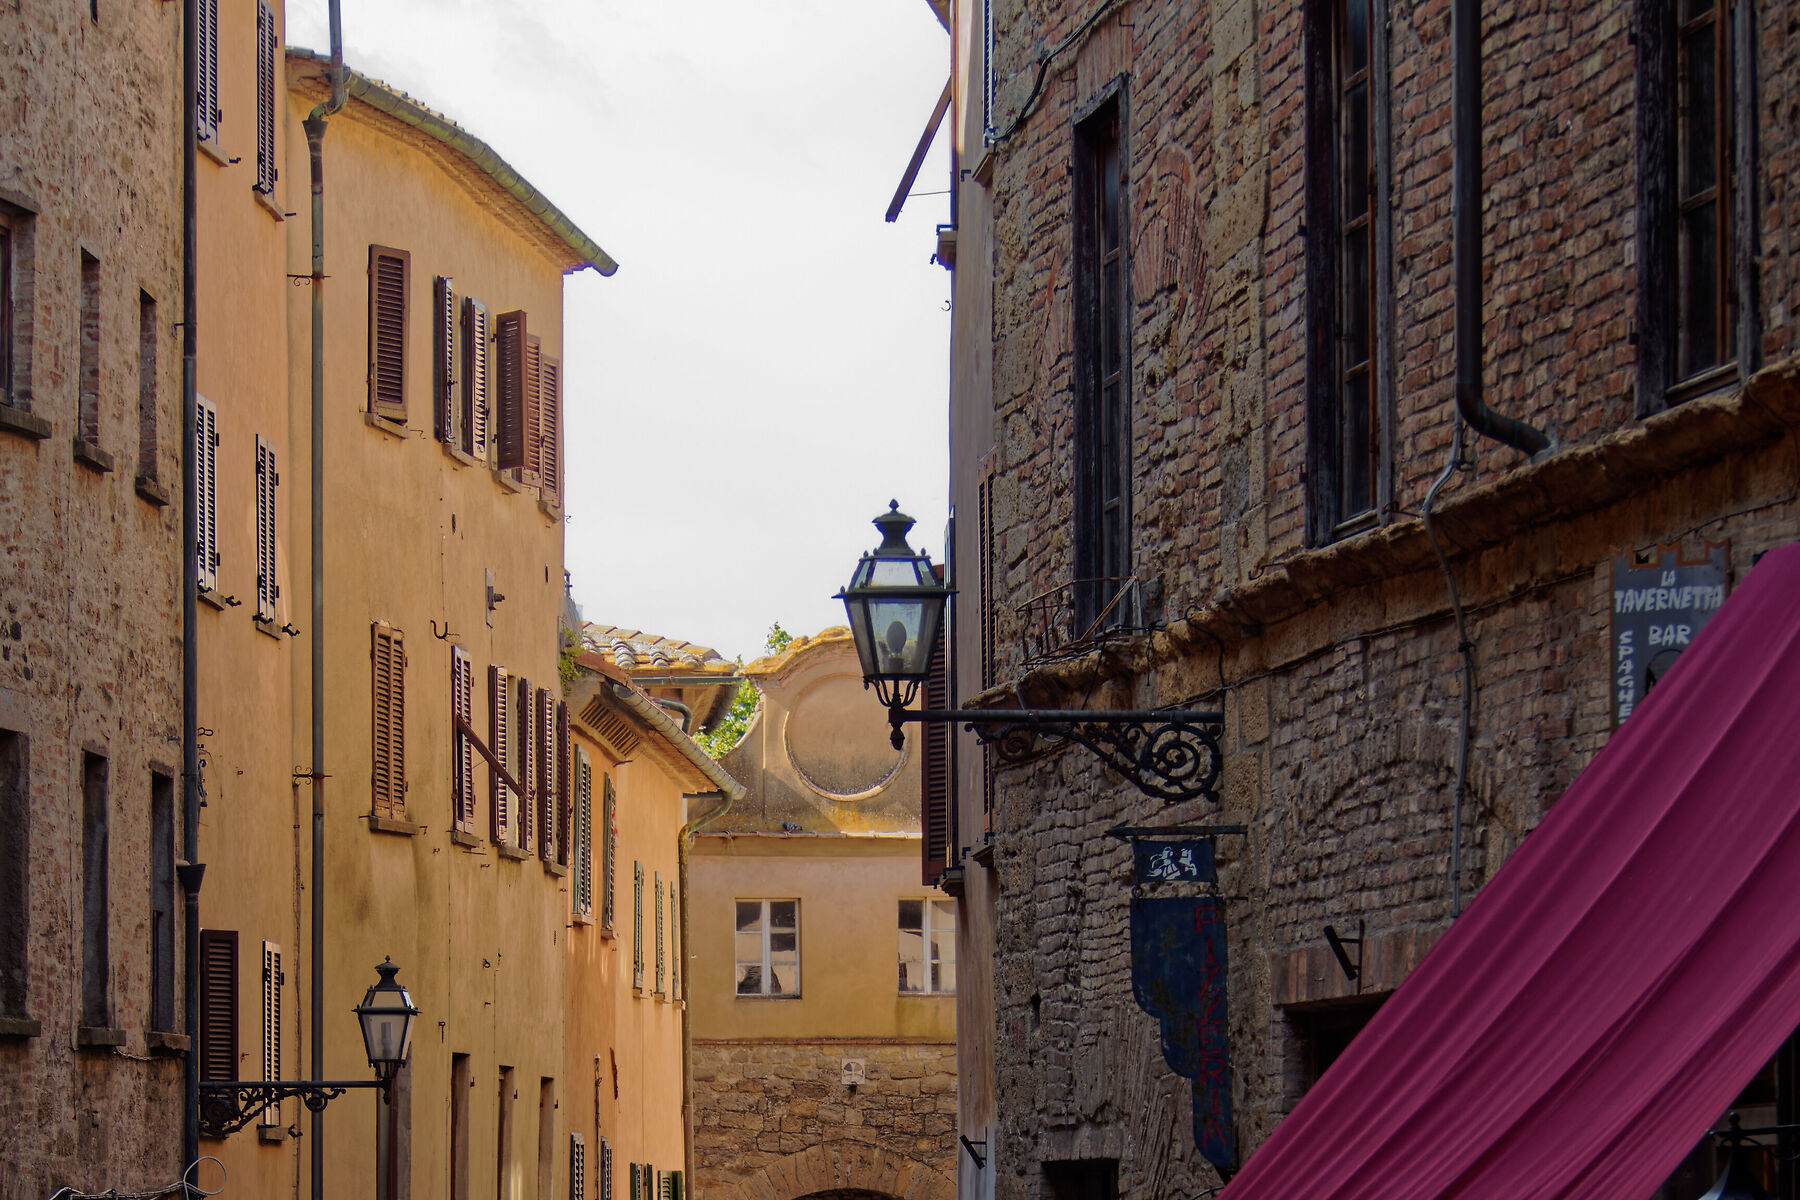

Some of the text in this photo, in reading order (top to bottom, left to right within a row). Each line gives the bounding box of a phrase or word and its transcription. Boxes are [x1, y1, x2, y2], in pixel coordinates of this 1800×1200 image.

[1661, 570, 1676, 587] LA
[1614, 584, 1723, 613] TAVERNETTA
[1648, 624, 1691, 646] BAR
[1617, 630, 1634, 725] SPAGHE
[1194, 906, 1227, 1148] PIZZERIA
